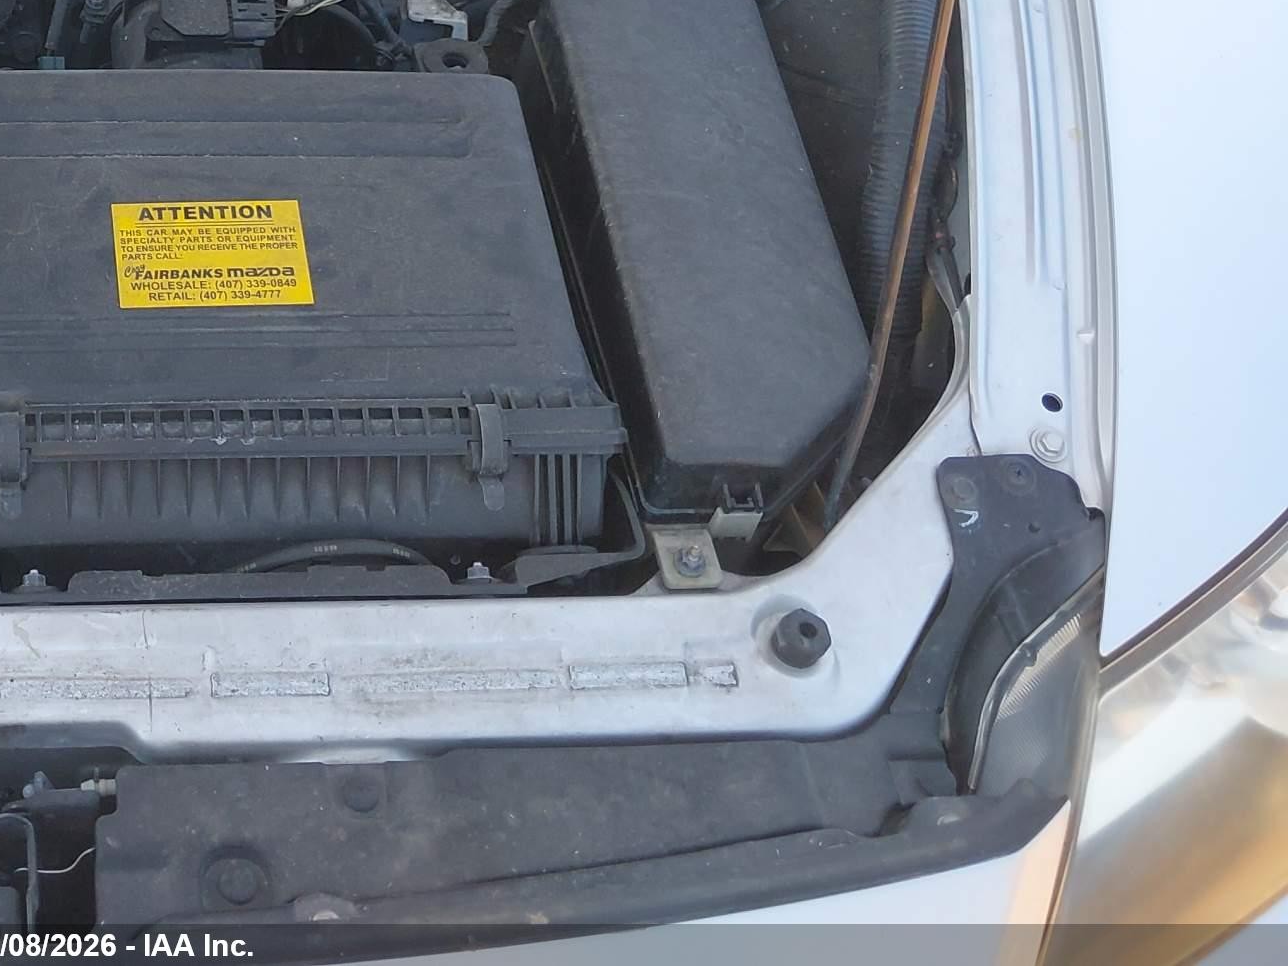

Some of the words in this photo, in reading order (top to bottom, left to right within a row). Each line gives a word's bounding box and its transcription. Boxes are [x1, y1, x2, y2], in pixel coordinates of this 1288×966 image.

[138, 205, 272, 221] ATTENTION
[120, 229, 142, 237] THIS
[146, 228, 167, 236] CAR
[172, 228, 193, 236] MAY
[215, 226, 266, 235] EQUIPPED
[270, 226, 297, 234] WITH
[120, 236, 175, 245] SPECIALTY
[179, 235, 212, 243] PARTS
[121, 245, 133, 253] TO
[136, 244, 174, 252] ENSURE
[197, 243, 237, 251] RECEIVE
[239, 242, 258, 250] THE
[260, 242, 298, 250] PROPER
[122, 253, 153, 261] PARTS
[155, 252, 184, 260] CALL:
[135, 267, 223, 280] FAIRBANKS
[130, 281, 212, 291] WHOLESALE:
[215, 280, 243, 290] (407)
[246, 278, 297, 288] 339-0849
[148, 291, 196, 301] RETAIL:
[199, 290, 228, 301] (407)
[231, 289, 282, 299] 339-4777
